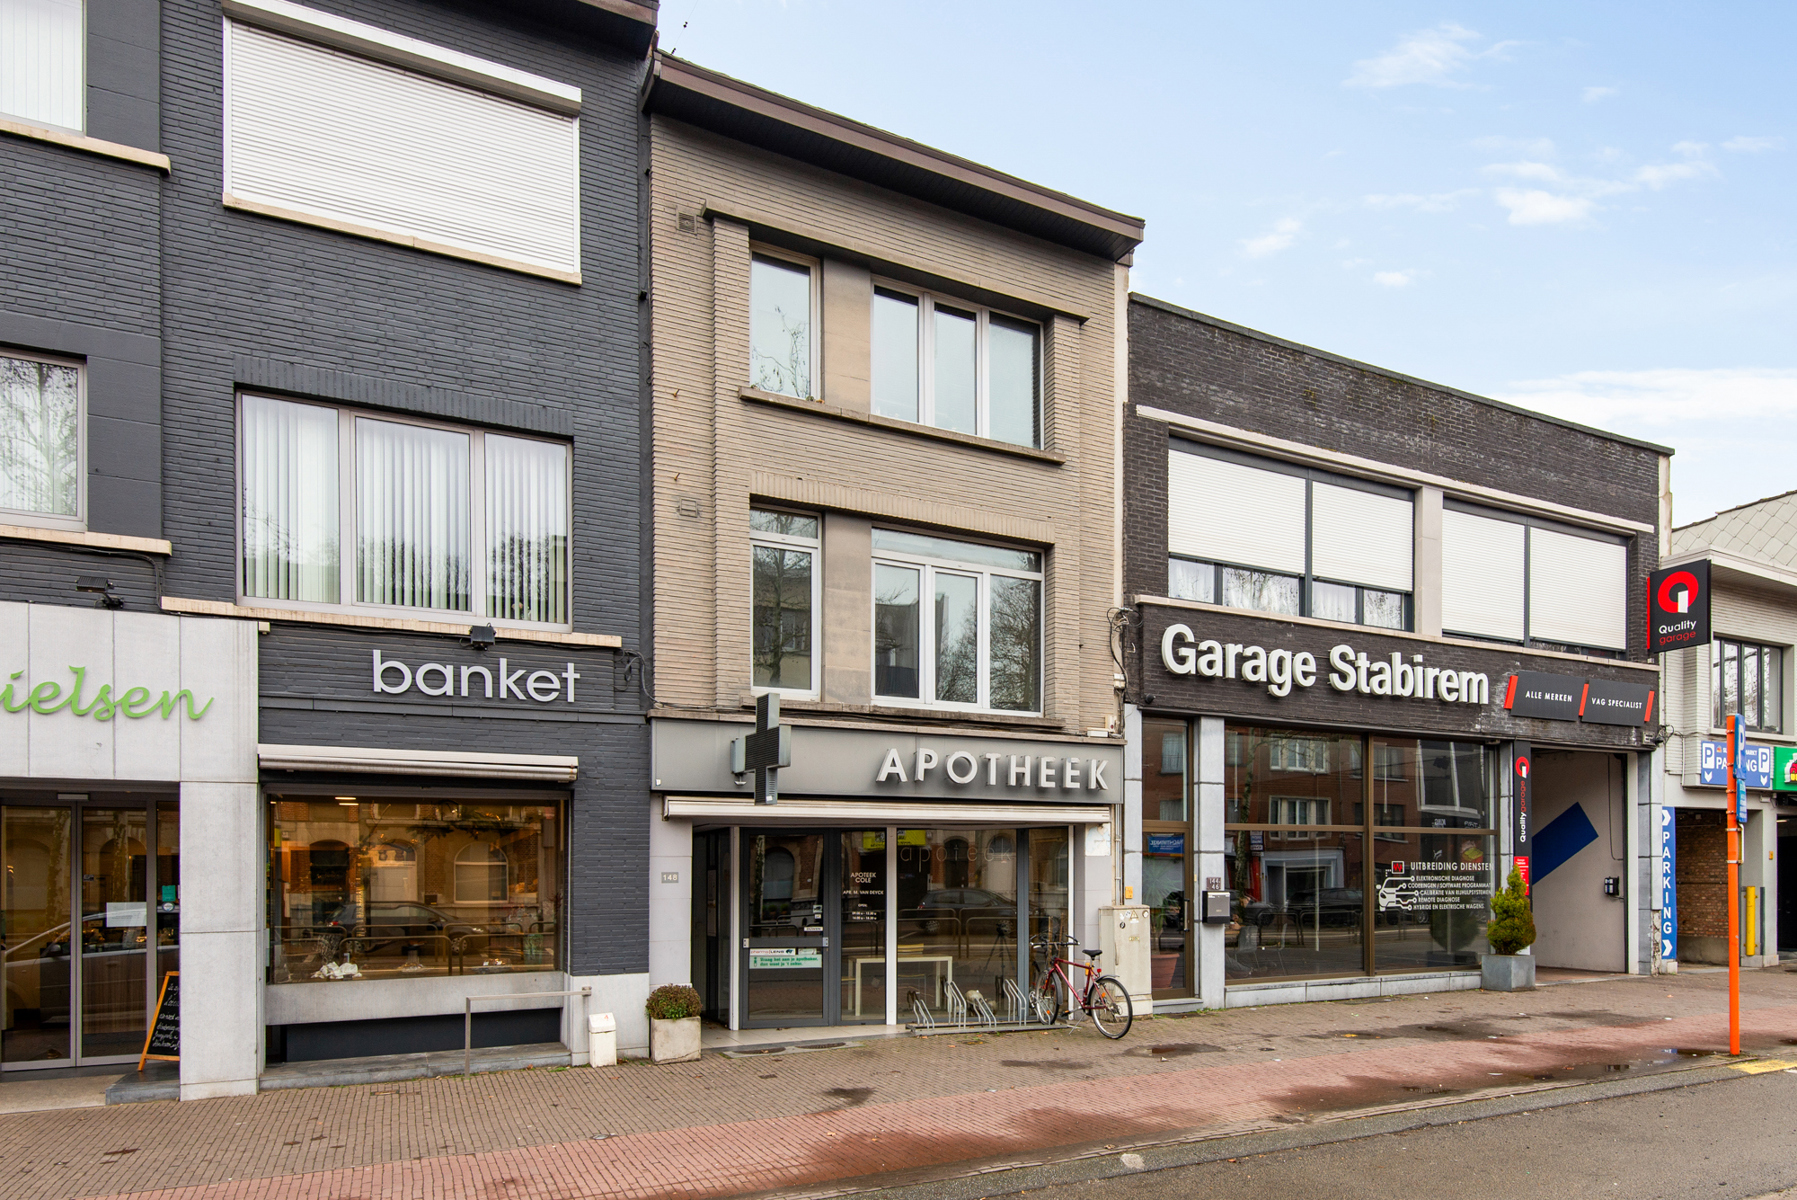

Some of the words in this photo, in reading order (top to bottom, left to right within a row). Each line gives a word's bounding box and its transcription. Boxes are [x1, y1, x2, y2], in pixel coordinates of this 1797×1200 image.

[1658, 620, 1697, 634] Quality
[1659, 631, 1696, 646] garage
[1161, 623, 1317, 698] Garage
[1328, 644, 1489, 705] Stabirem
[372, 649, 581, 703] banket
[1525, 690, 1542, 700] ALLE
[1544, 692, 1573, 703] MERKEN
[1591, 697, 1606, 706] VAG
[1607, 699, 1643, 709] SPECIALIST
[1704, 746, 1713, 765] P
[1738, 724, 1744, 769] P
[876, 748, 1109, 791] APOTHEEK
[1716, 756, 1758, 772] PANG
[1761, 752, 1768, 772] P
[900, 838, 1012, 873] apoteek
[1410, 862, 1458, 871] UITBREIDING
[1460, 862, 1494, 871] DIENSTEN
[1662, 831, 1672, 935] PARKING
